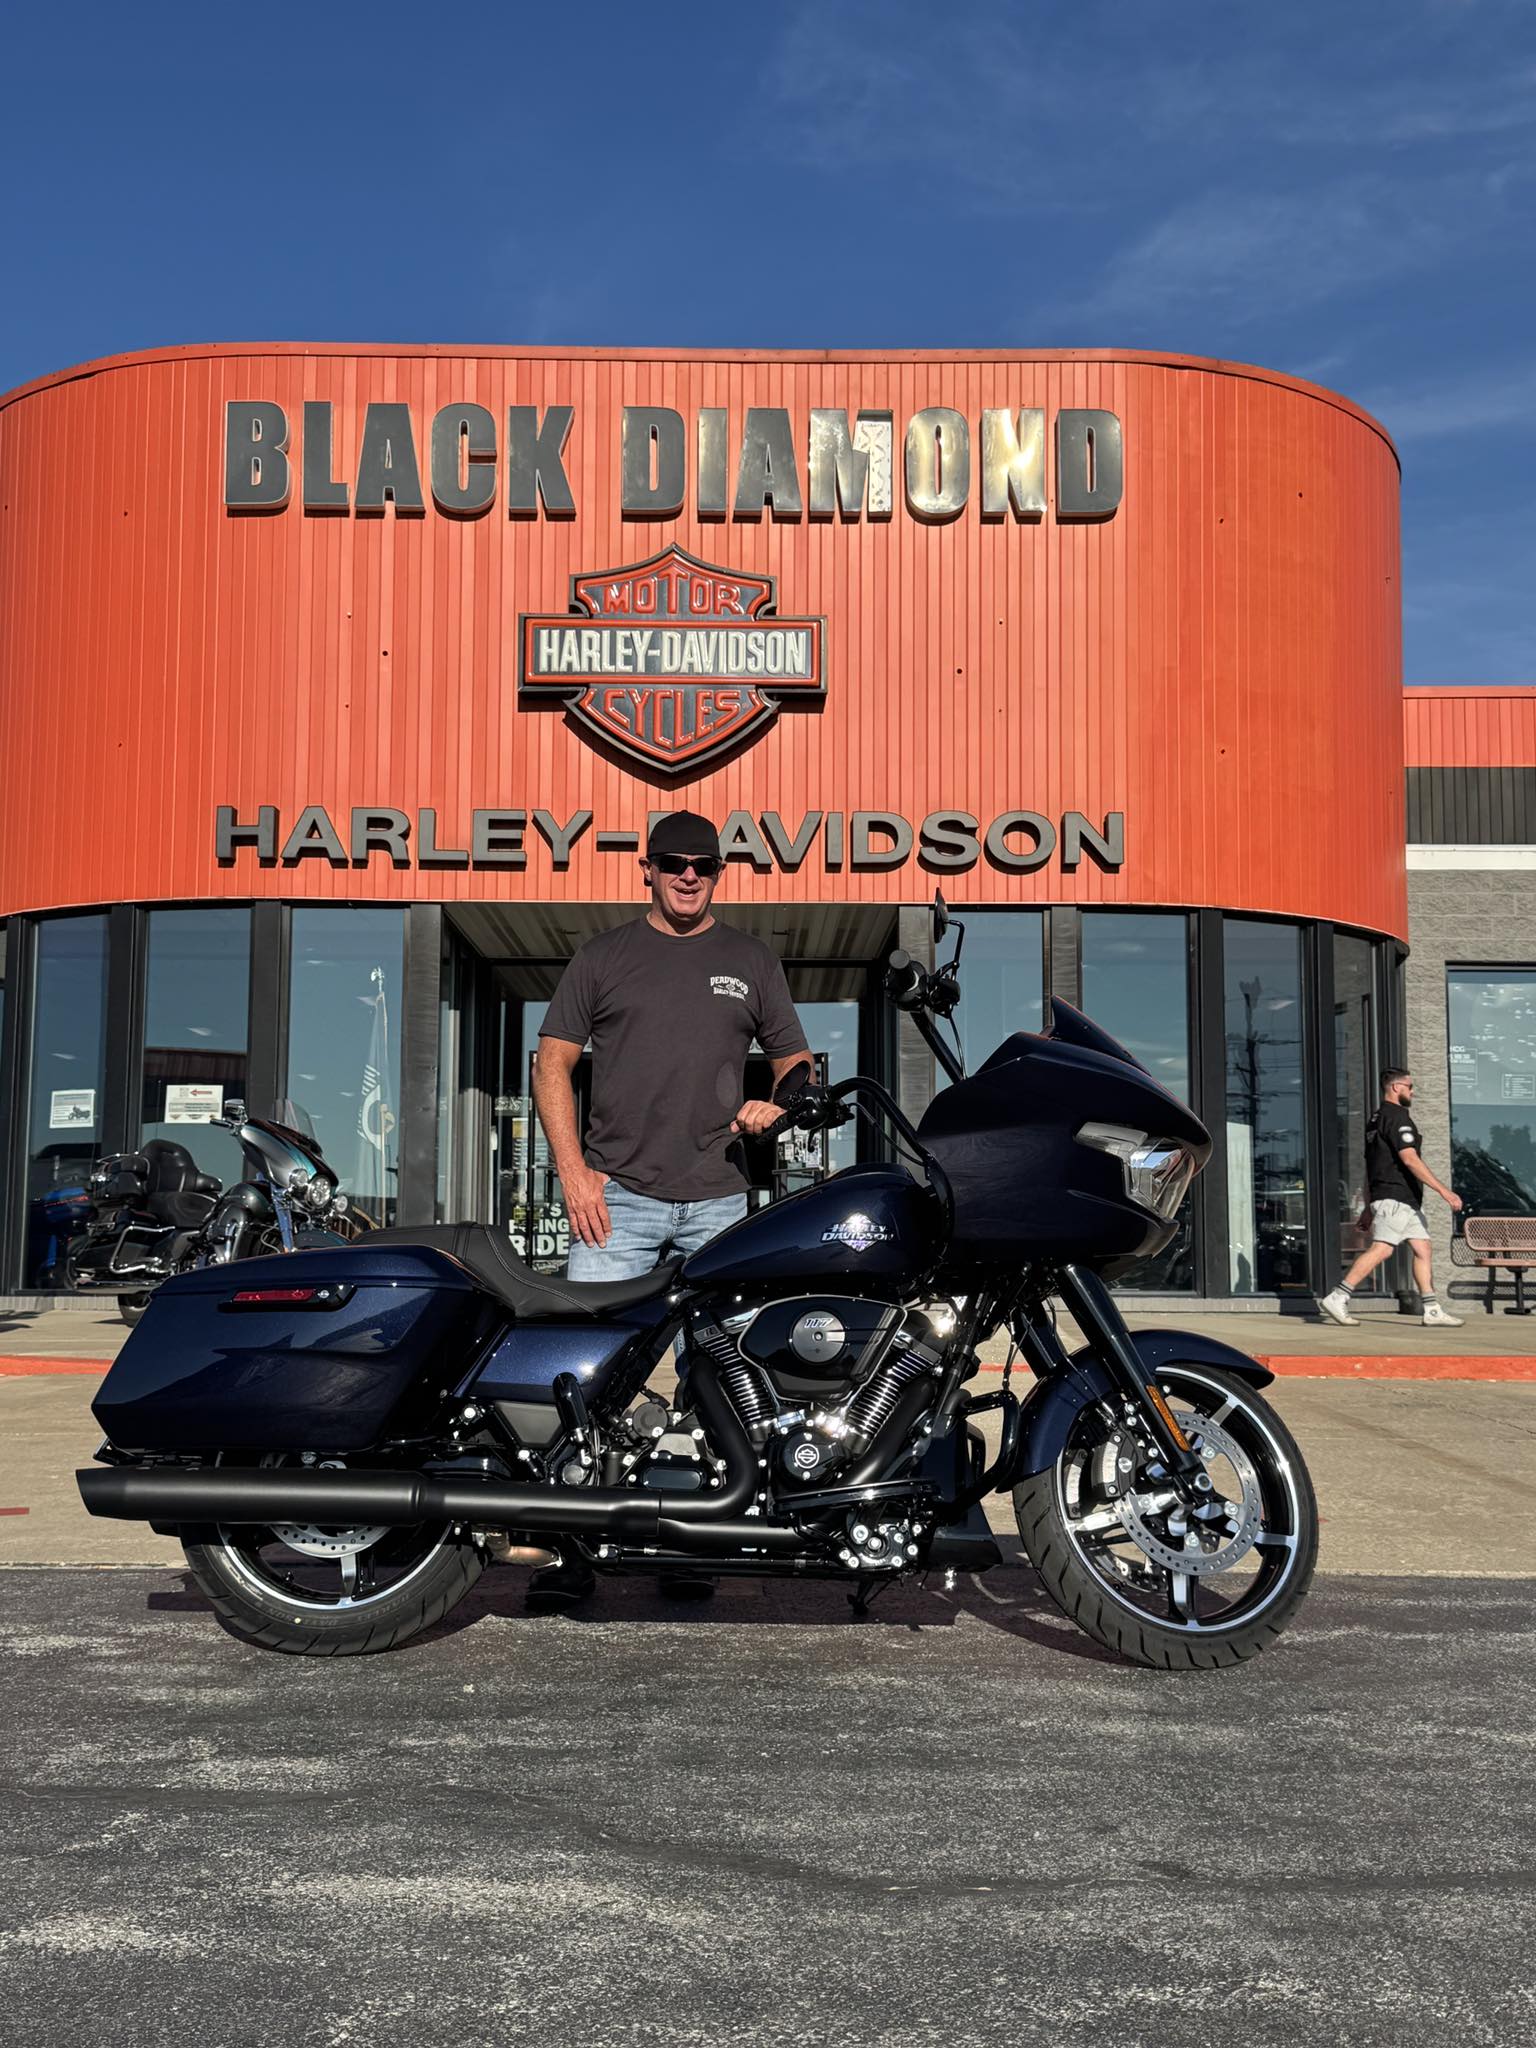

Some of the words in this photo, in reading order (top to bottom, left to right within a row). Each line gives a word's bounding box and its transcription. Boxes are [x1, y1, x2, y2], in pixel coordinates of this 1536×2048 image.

[225, 400, 576, 516] BLACK
[621, 406, 1124, 521] DIAMOND
[603, 562, 745, 615] MOTOR
[539, 628, 806, 674] HARLEY-DAVIDSON
[603, 688, 741, 750] CYCLES
[215, 804, 1124, 870] HARLEY-AVIDSON
[710, 976, 749, 995] DEADWOOD
[827, 1222, 888, 1233] HALEY-
[804, 1317, 834, 1329] 117
